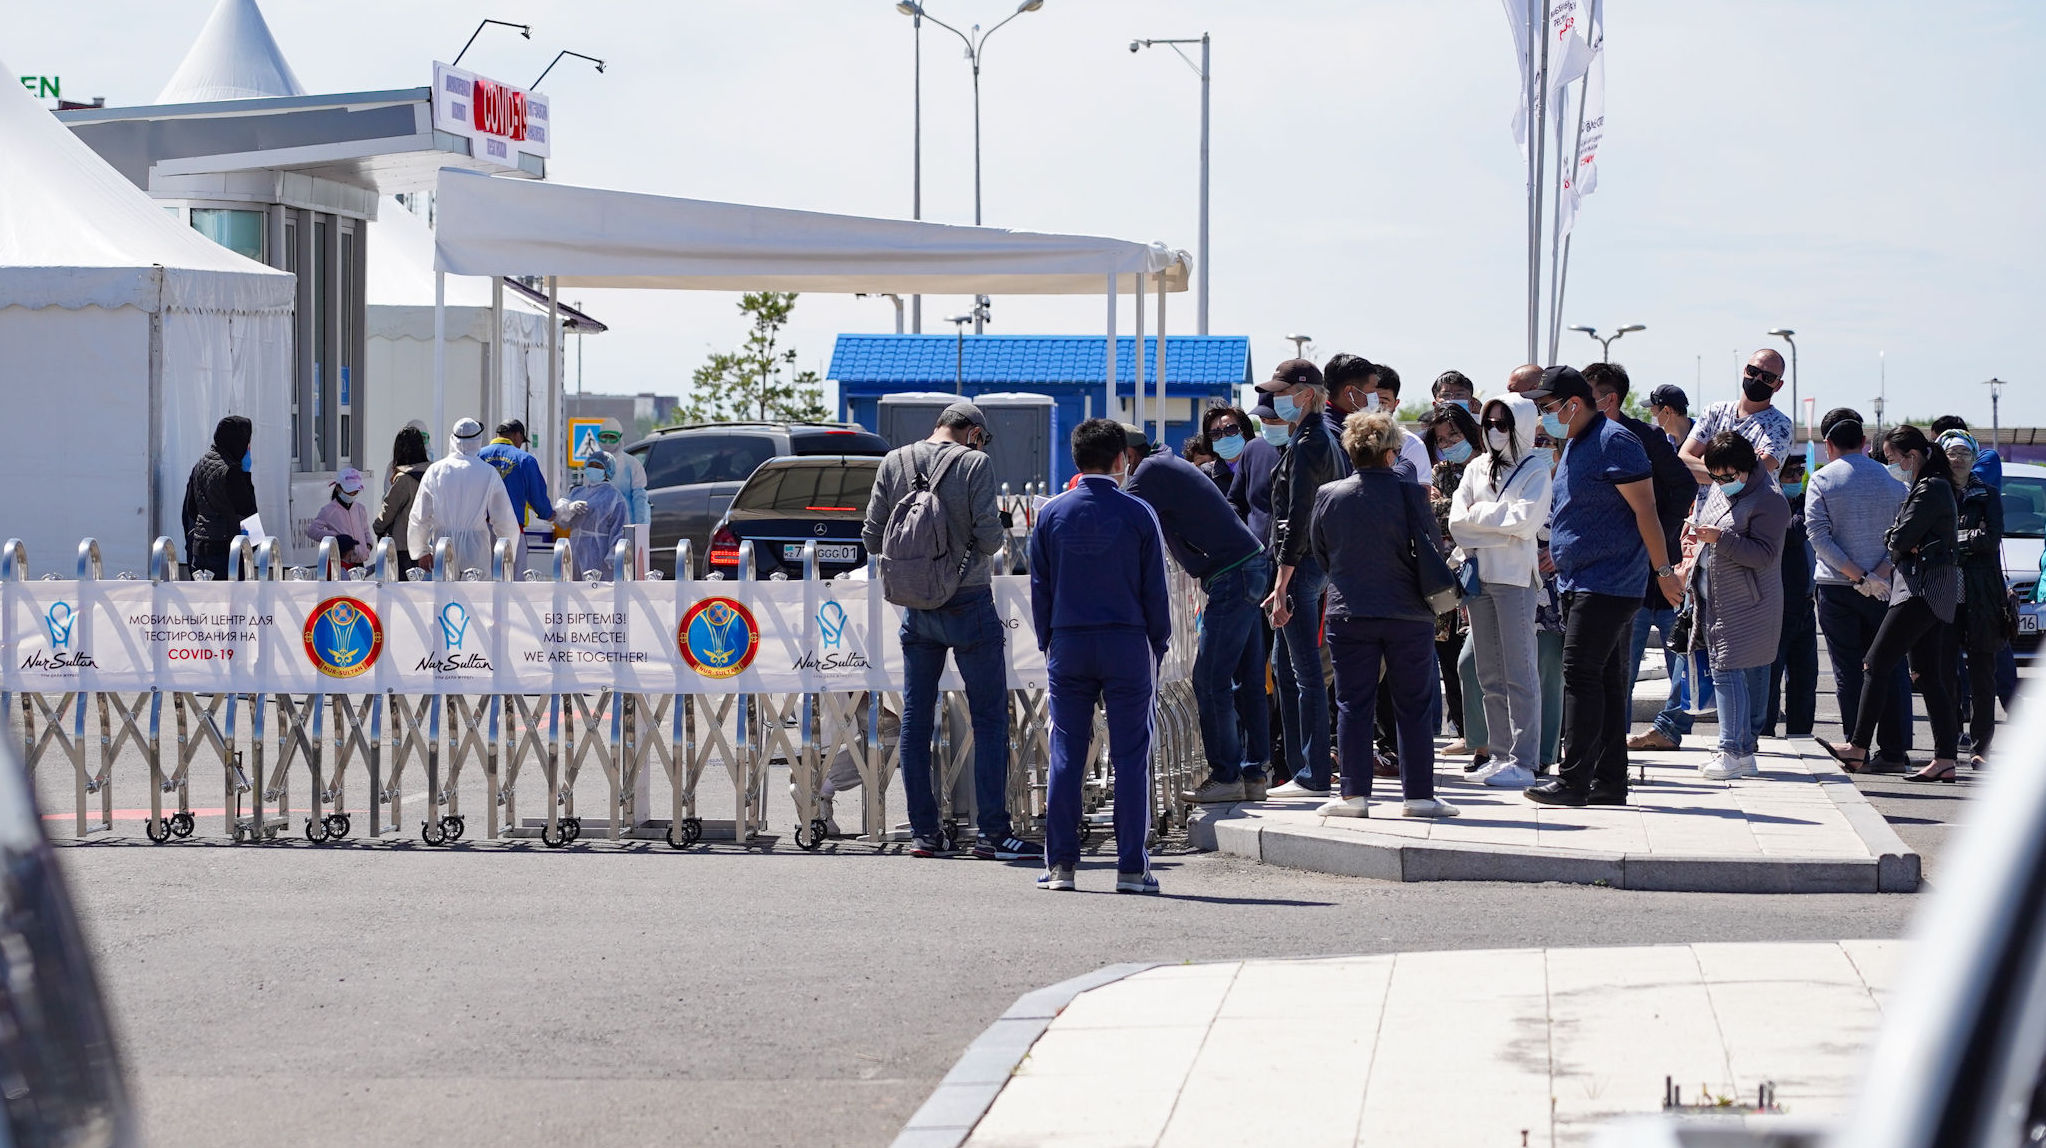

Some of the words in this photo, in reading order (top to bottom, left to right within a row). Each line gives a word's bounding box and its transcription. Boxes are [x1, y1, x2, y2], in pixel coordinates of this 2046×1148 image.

[483, 84, 528, 140] COVID-19
[129, 613, 208, 625] МОБИЛЬНЫЙ
[211, 615, 246, 626] ЦЕНТР
[249, 615, 273, 626] ДЛЯ
[544, 612, 563, 625] БІЗ
[567, 612, 627, 625] БІРГЕМІЗ!
[145, 631, 237, 642] ТЕСТИРОВАНИЯ
[240, 631, 257, 642] НА
[543, 631, 567, 643] МЫ
[571, 631, 627, 643] ВМЕСТЕ!
[168, 648, 234, 660] COVID-19
[524, 651, 544, 663] WE
[547, 651, 573, 663] ARE
[577, 651, 649, 663] TOGETHER!
[323, 665, 363, 676] NUR-SULTAN
